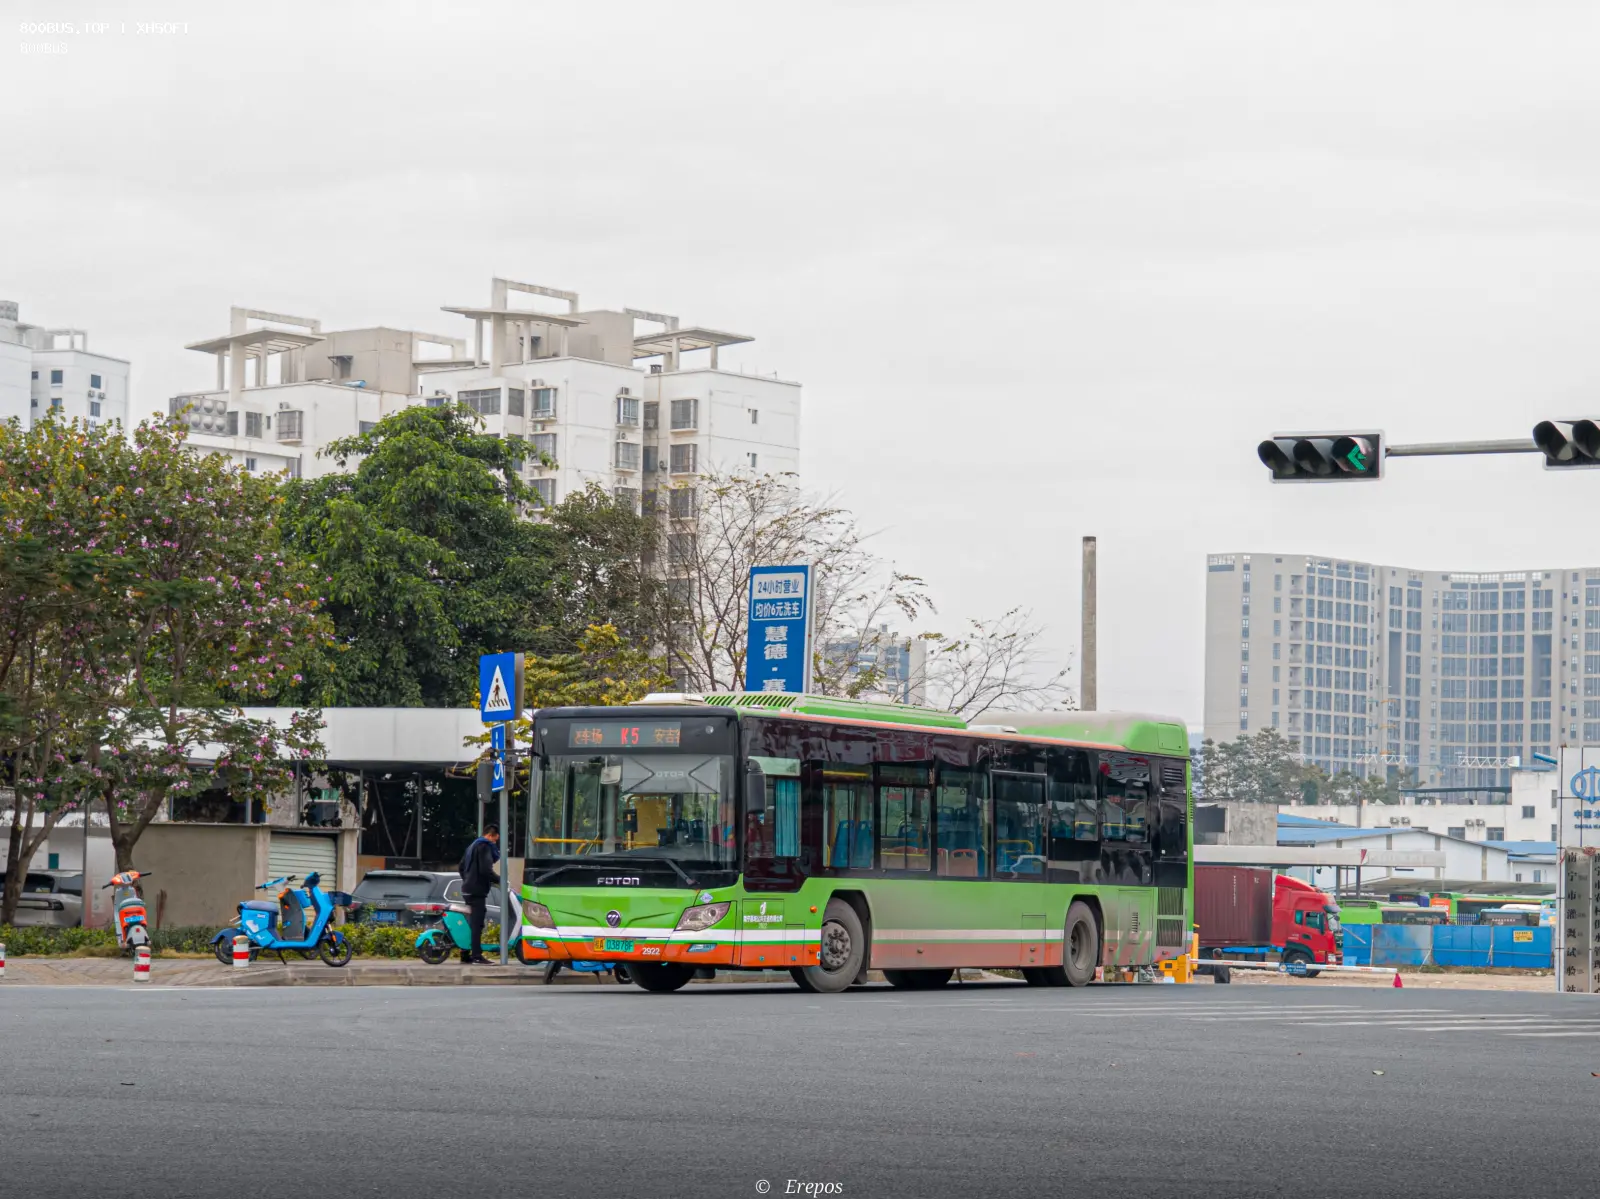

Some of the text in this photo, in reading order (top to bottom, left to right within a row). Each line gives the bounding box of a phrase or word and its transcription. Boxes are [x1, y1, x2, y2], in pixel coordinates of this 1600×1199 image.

[757, 579, 799, 594] 24小时营业
[755, 601, 800, 617] 均价6元洗车
[621, 727, 640, 744] K5
[597, 877, 640, 886] FOTON
[642, 947, 660, 955] 2922
